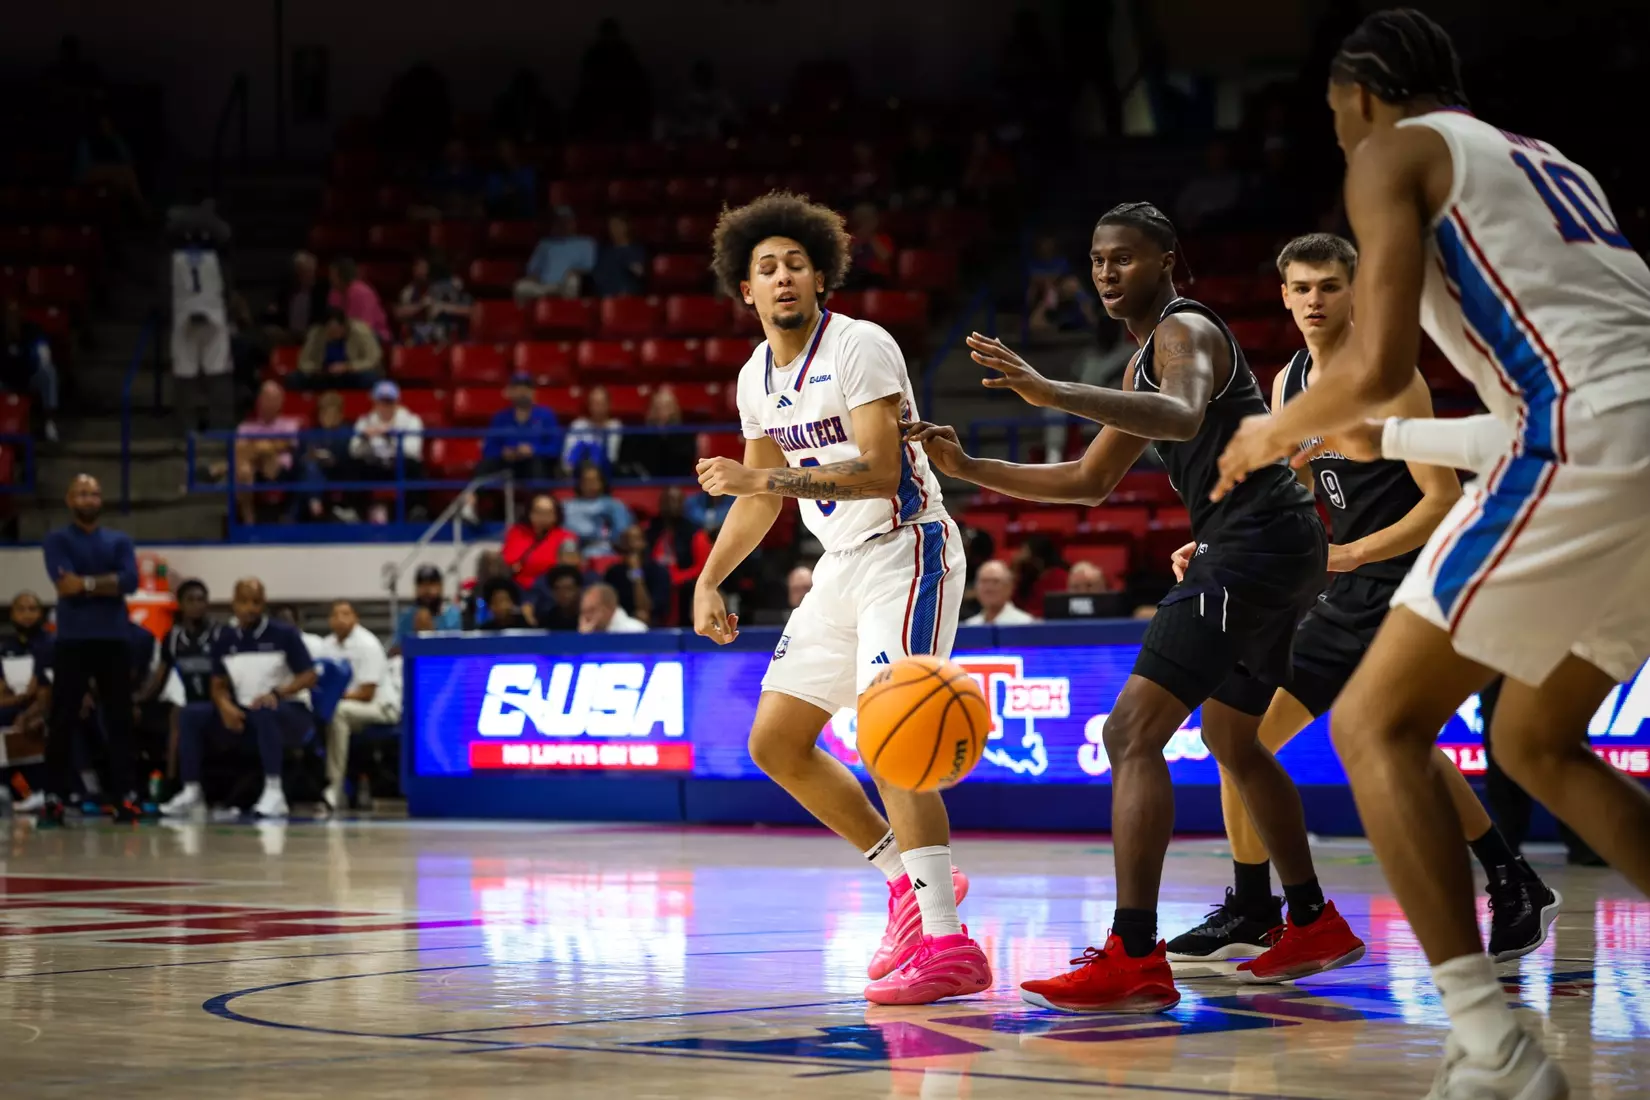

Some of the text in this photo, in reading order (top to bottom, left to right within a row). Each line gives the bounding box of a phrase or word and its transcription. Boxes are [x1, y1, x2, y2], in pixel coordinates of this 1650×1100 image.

[1510, 150, 1634, 249] 10
[805, 416, 848, 449] TECH
[1320, 470, 1346, 509] 9
[629, 745, 658, 765] US
